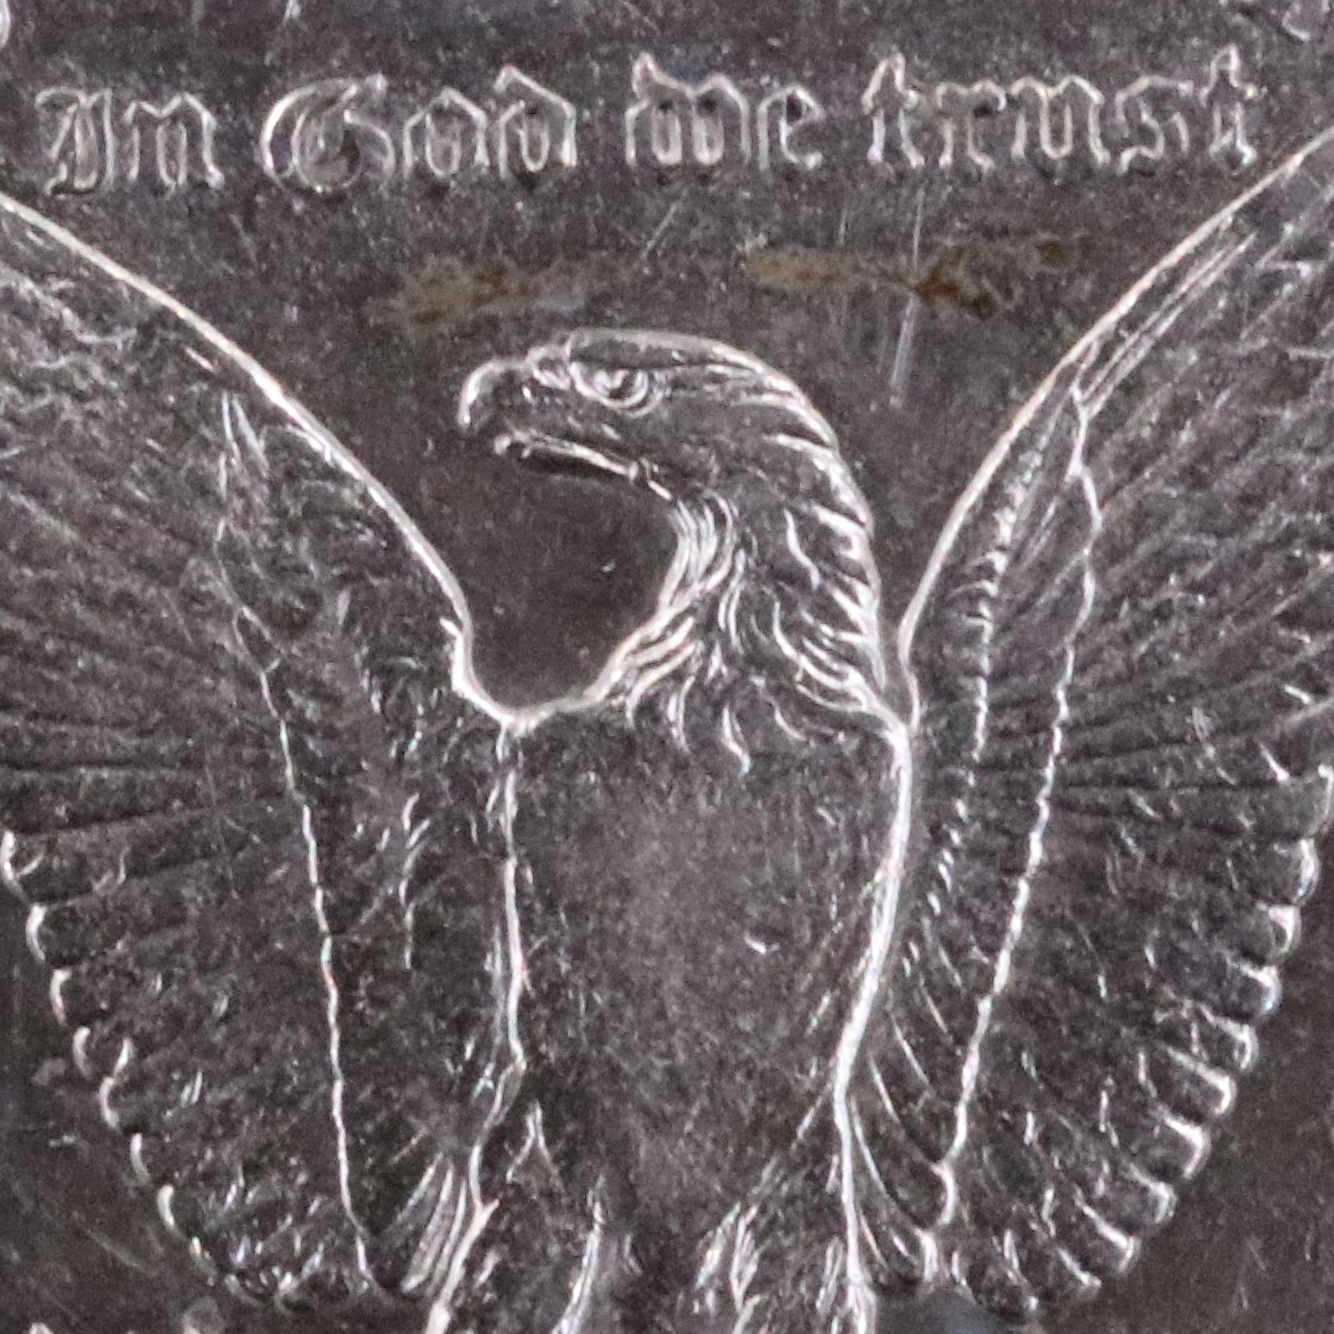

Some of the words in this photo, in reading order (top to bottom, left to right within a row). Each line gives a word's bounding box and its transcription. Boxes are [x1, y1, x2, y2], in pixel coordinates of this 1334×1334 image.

[35, 83, 225, 200] In
[260, 64, 577, 194] God
[625, 51, 825, 171] we
[862, 43, 1259, 175] trust
